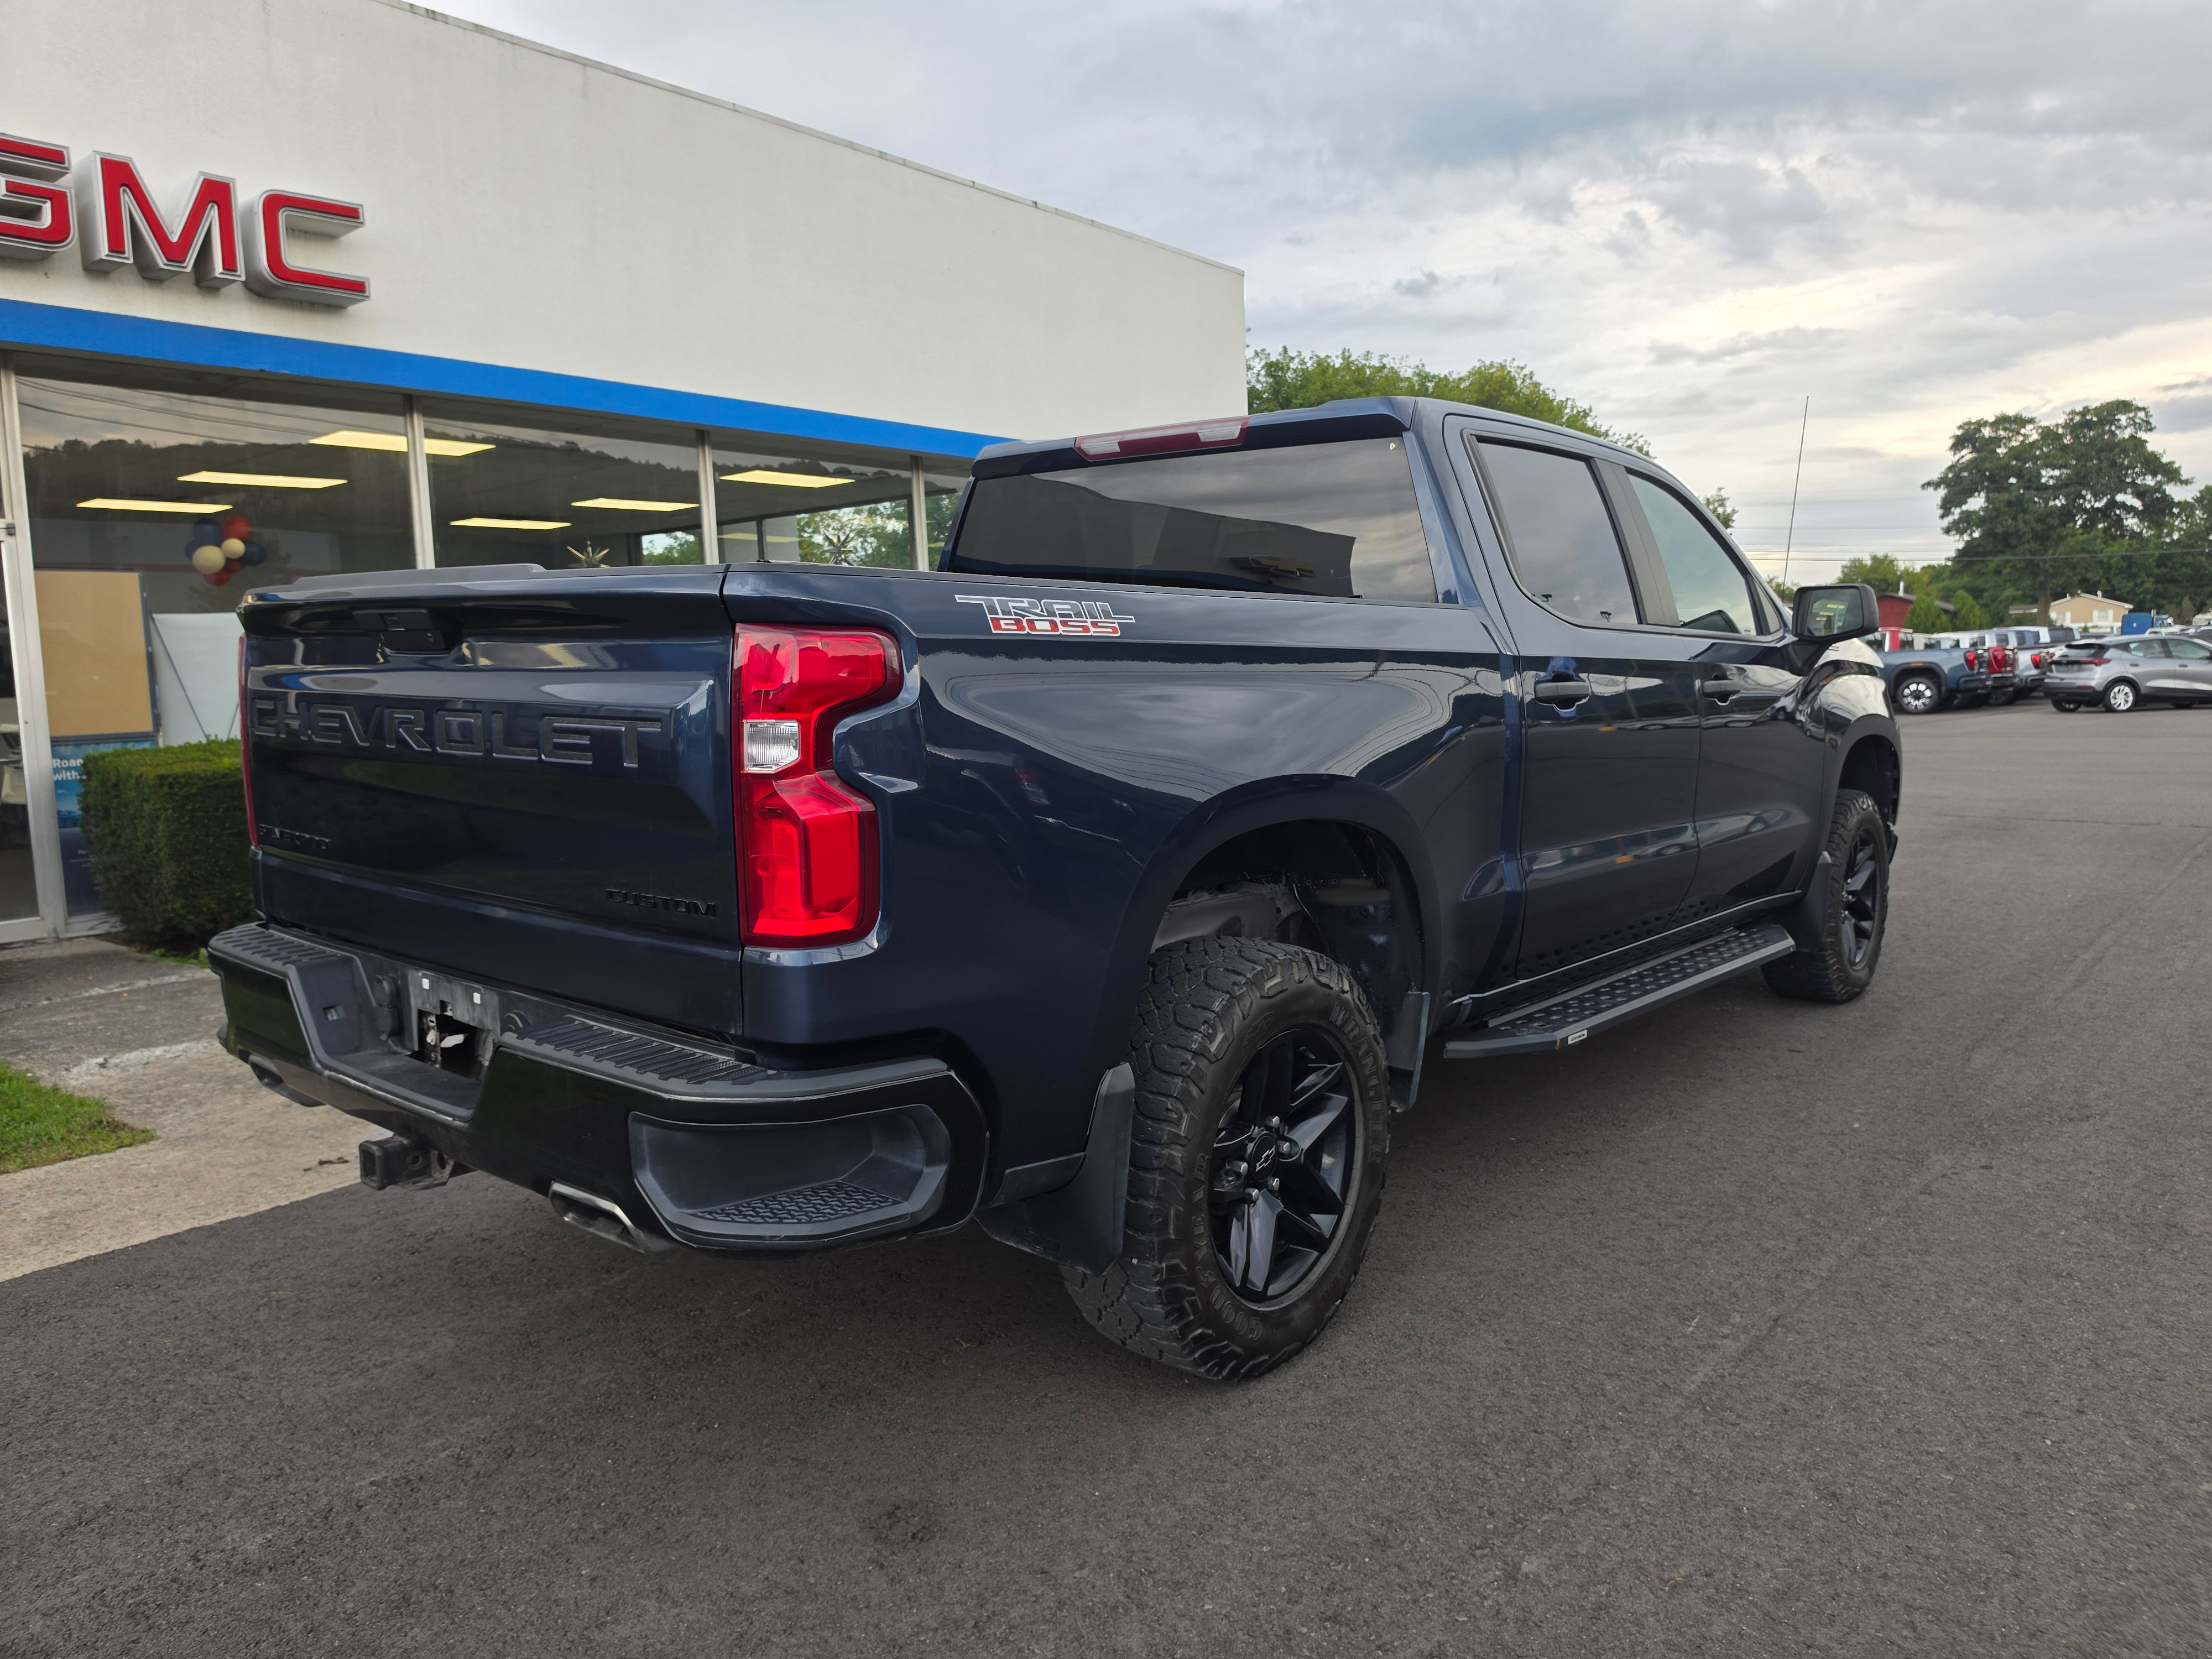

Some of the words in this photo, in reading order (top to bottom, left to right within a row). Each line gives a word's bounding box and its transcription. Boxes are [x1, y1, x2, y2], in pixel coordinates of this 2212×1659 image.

[0, 133, 371, 309] GMC
[954, 594, 1136, 623] TRAIL
[989, 615, 1121, 636] BOSS
[253, 698, 662, 768] CHEVROLET
[606, 889, 717, 917] CUSTOM
[1328, 1001, 1384, 1164] WRANGLER
